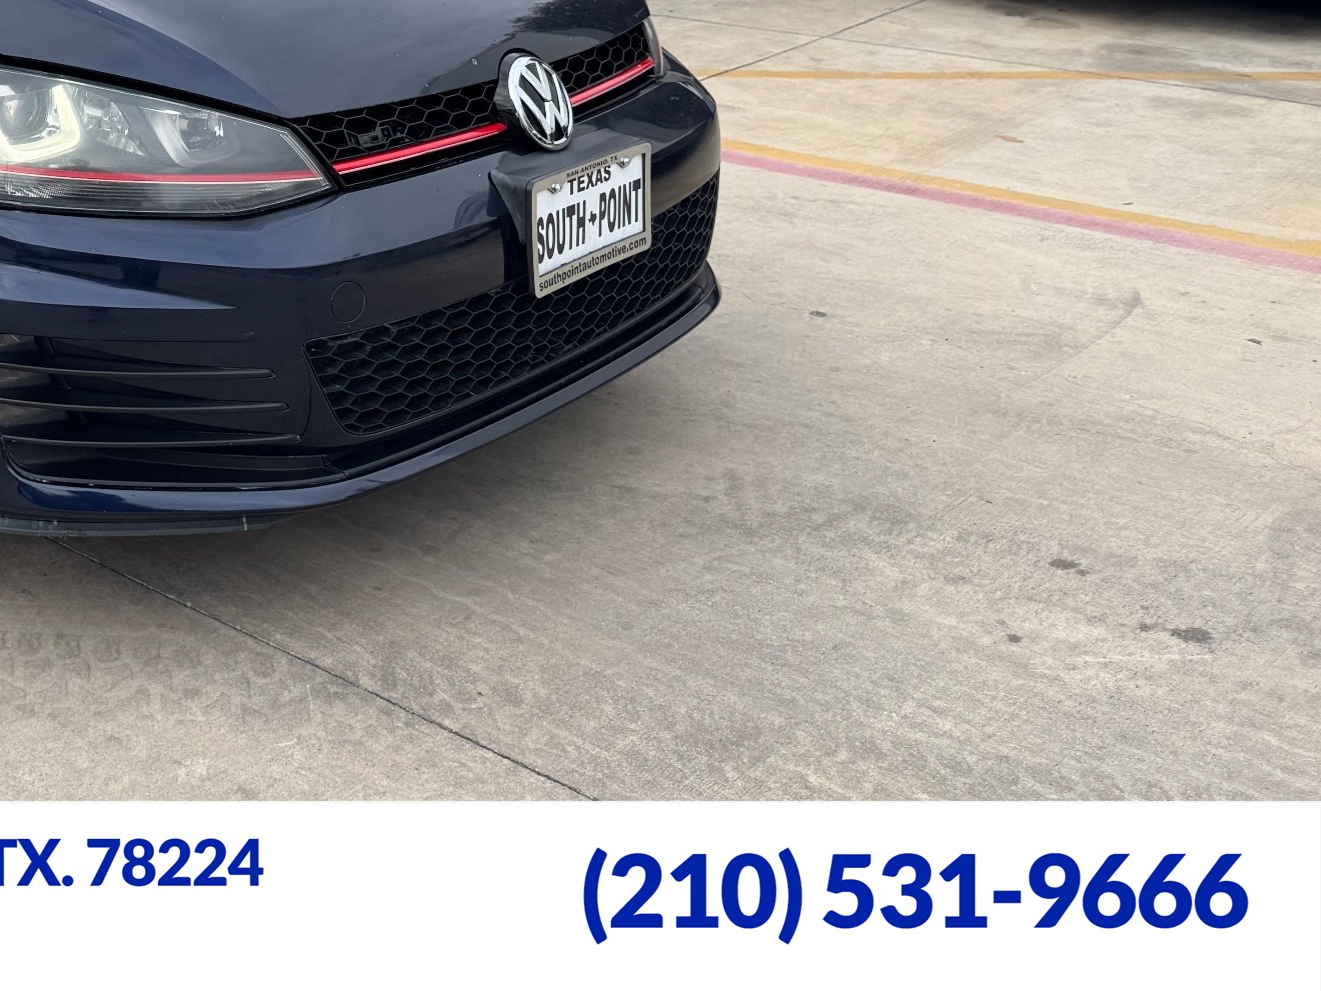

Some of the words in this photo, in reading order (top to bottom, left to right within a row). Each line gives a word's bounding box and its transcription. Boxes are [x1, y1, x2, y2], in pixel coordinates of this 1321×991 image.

[567, 169, 579, 178] SAN
[567, 165, 611, 196] TEXAS
[537, 200, 586, 264] SOUTH
[598, 178, 641, 237] POINT
[539, 236, 647, 292] southpointautomotive.com
